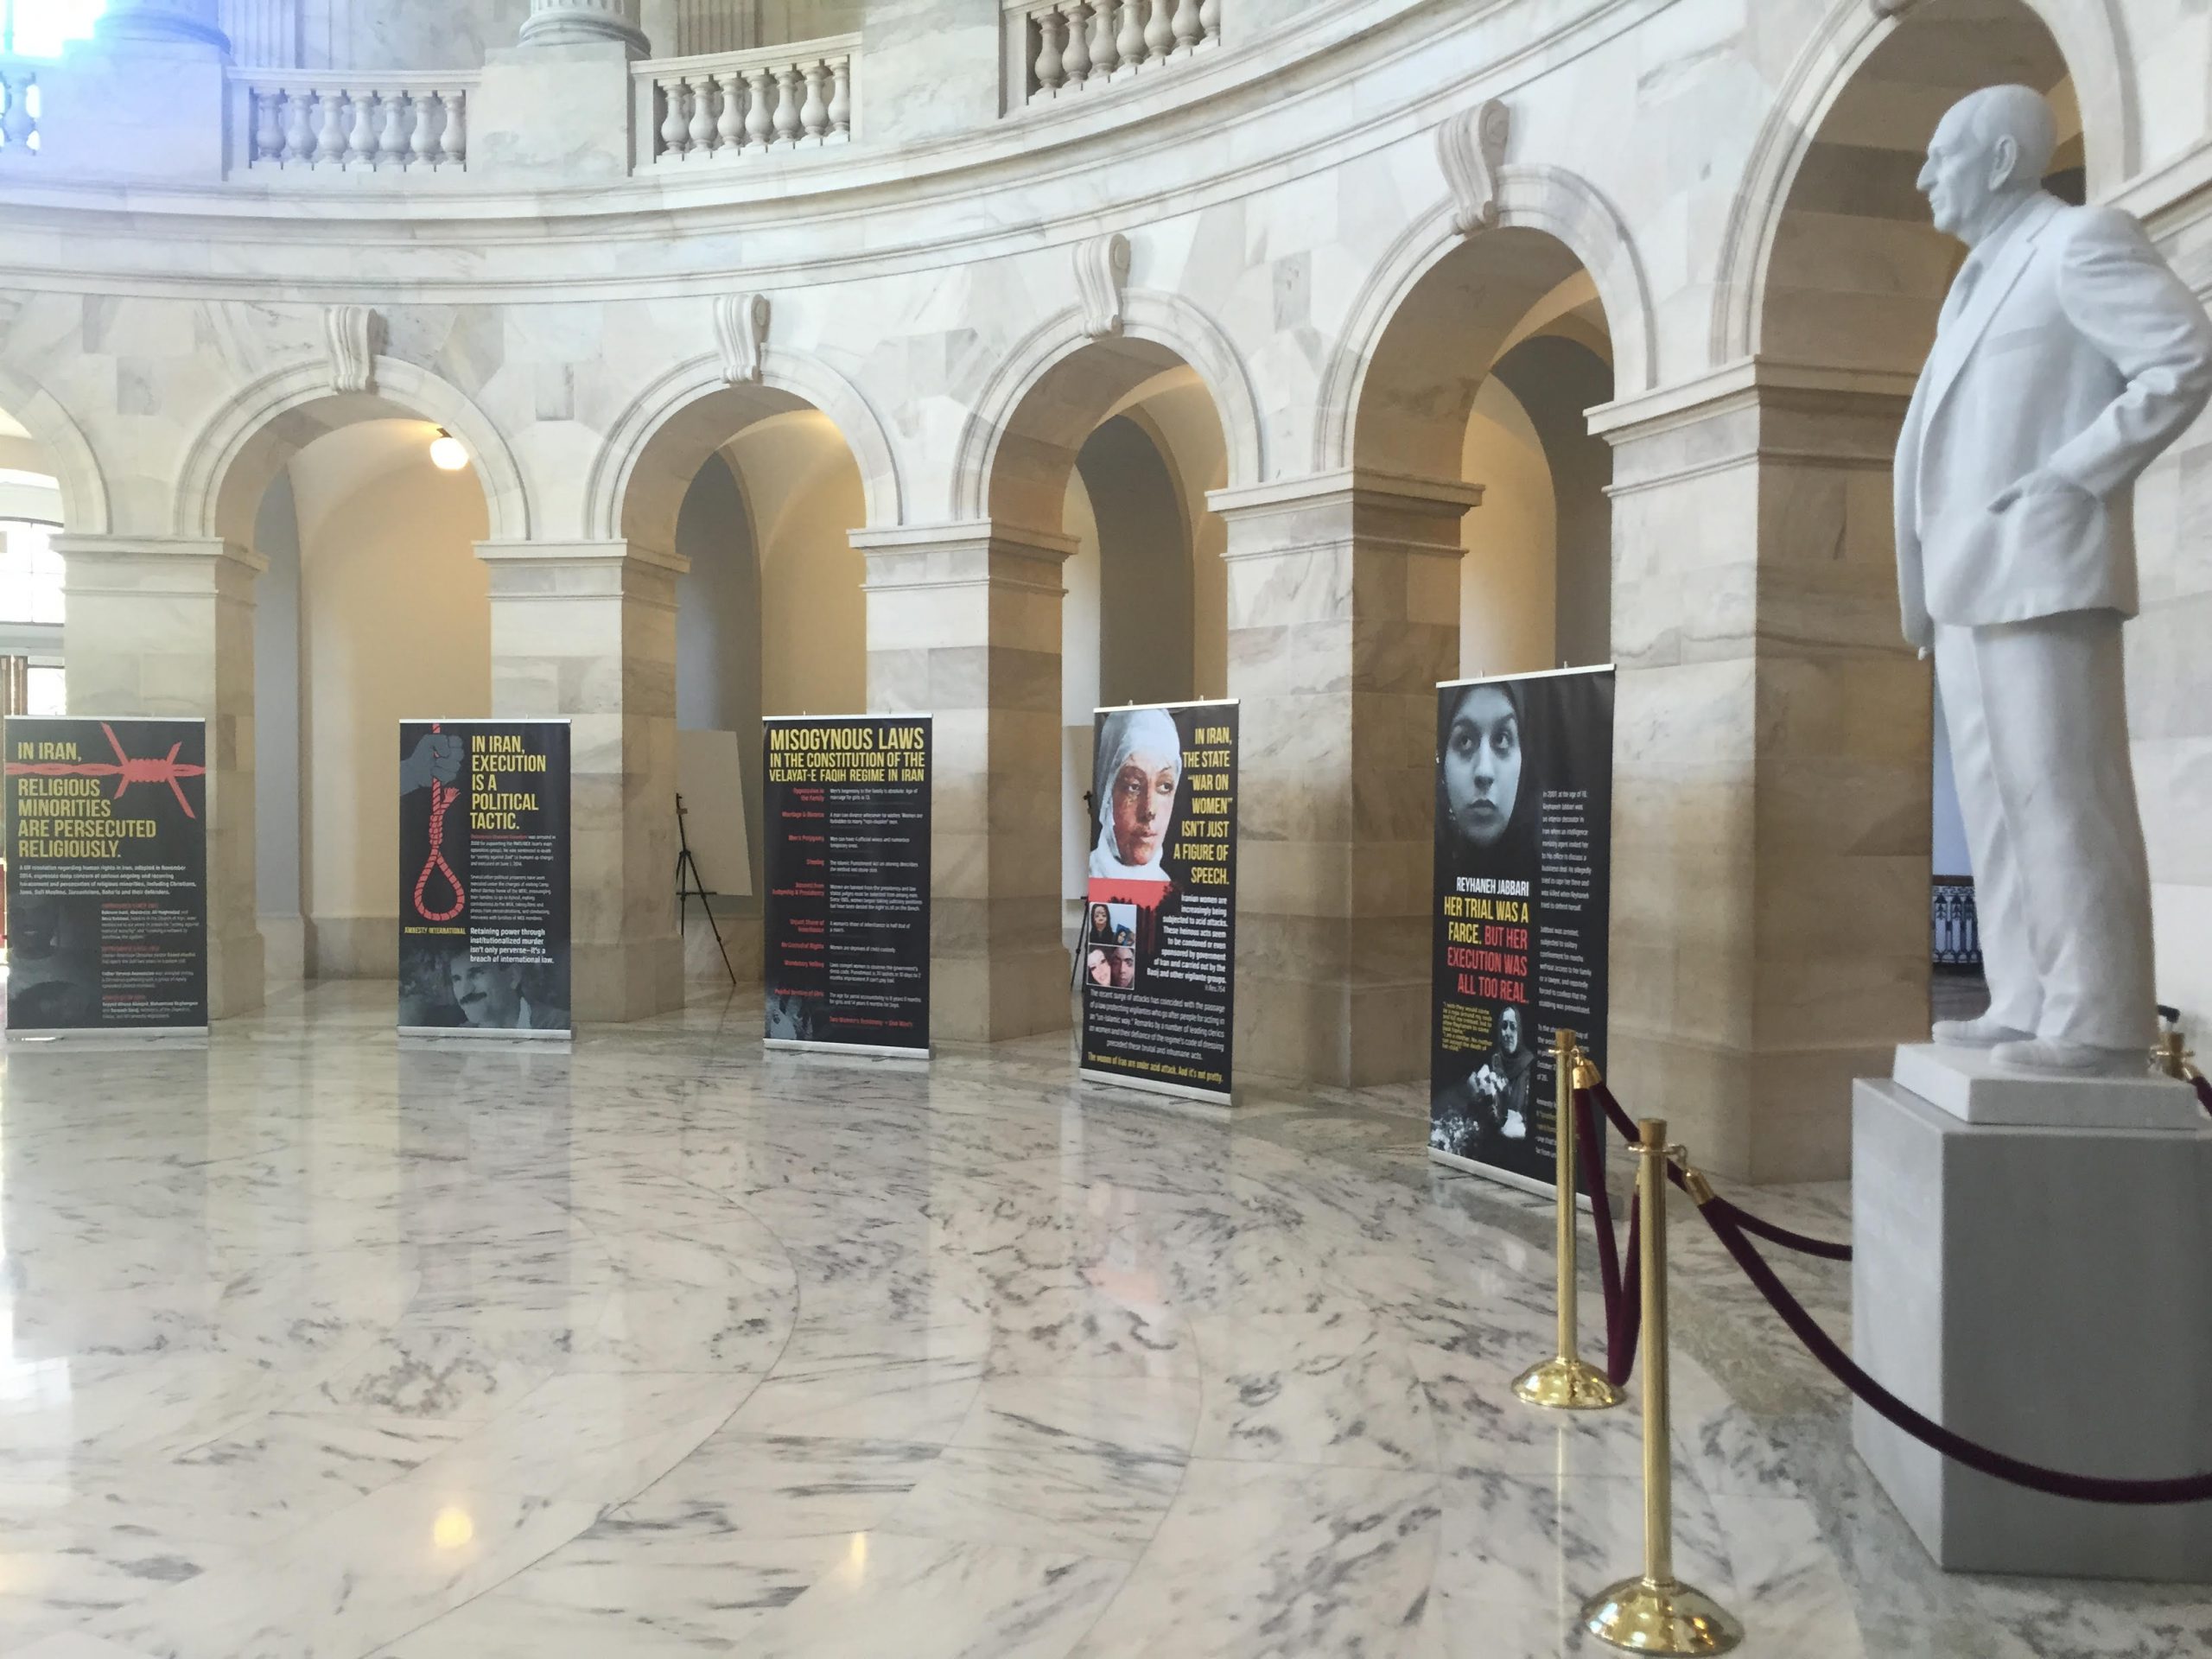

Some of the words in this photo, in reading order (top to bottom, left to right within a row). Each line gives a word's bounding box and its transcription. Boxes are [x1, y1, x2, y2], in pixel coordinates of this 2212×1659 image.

[472, 736, 486, 752] IN
[489, 736, 524, 754] IRAN,
[771, 728, 873, 750] MISOGYNOUS
[879, 728, 924, 749] LAWS
[1195, 728, 1205, 745] IN
[1206, 728, 1232, 745] IRAN,
[18, 742, 33, 760] IN
[39, 742, 82, 761] IRAN,
[770, 753, 781, 767] IN
[785, 753, 804, 767] THE
[807, 753, 885, 767] CONSTITUTION
[887, 753, 900, 766] OF
[904, 752, 925, 766] THE
[1183, 752, 1199, 767] THE
[1202, 751, 1230, 767] STATE
[472, 755, 546, 772] EXECUTION
[472, 774, 484, 791] IS
[488, 774, 497, 791] A
[770, 769, 817, 781] VELAYAT-E
[820, 769, 847, 781] FAQIH
[849, 769, 885, 781] REGIME
[888, 769, 898, 781] IN
[901, 769, 924, 781] IRAN
[1215, 775, 1229, 791] ON
[18, 779, 100, 797] RELIGIOUS
[18, 799, 111, 817] MINORITIES
[472, 793, 538, 810] POLITICAL
[18, 820, 49, 836] ARE
[54, 820, 156, 837] PERSECUTED
[470, 812, 519, 830] TACTIC.
[1182, 821, 1204, 836] ISN'T
[1208, 821, 1230, 837] JUST
[18, 841, 121, 857] RELIGIOUSLY.
[1173, 843, 1180, 859] A
[1182, 844, 1214, 861] FIGURE
[1217, 844, 1229, 861] OF
[1192, 867, 1230, 885] SPEECH.
[1457, 877, 1496, 893] REYHANEH
[1498, 880, 1529, 896] JABBARI
[1444, 896, 1463, 916] HER
[1465, 898, 1493, 919] TRIAL
[1496, 900, 1518, 922] WAS
[1521, 902, 1529, 923] A
[470, 927, 499, 936] Retaining
[500, 928, 519, 937] power
[521, 928, 545, 937] through
[1448, 922, 1481, 945] FARCE.
[1484, 925, 1505, 947] BUT
[1506, 928, 1528, 950] HER
[1447, 947, 1502, 973] EXECUTION
[1504, 954, 1528, 976] WAS
[1458, 974, 1475, 995] ALL
[1478, 976, 1498, 999] TOO
[1499, 980, 1529, 1004] REAL.
